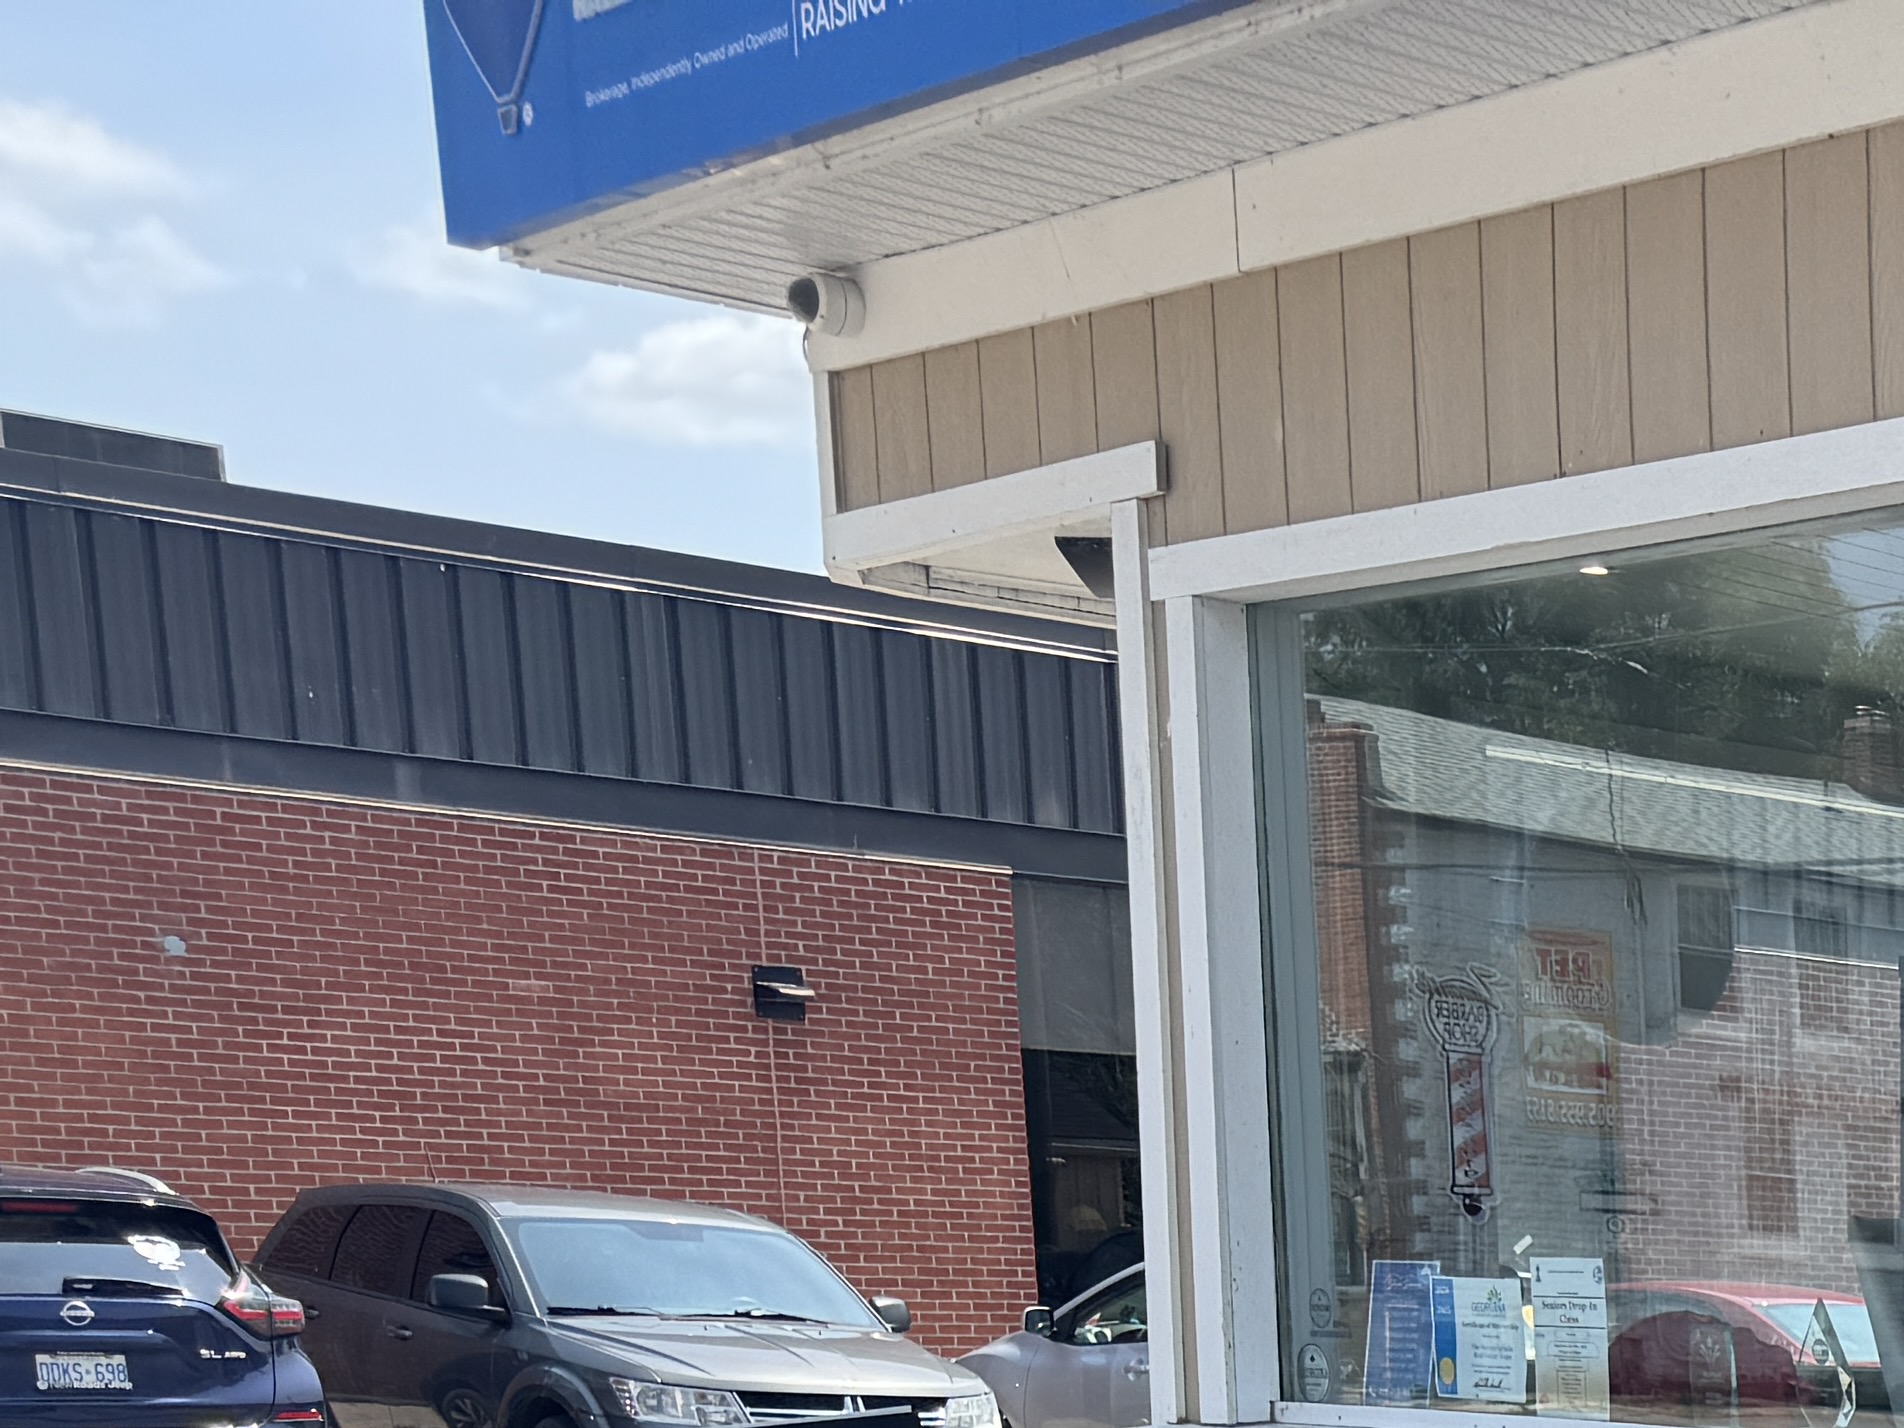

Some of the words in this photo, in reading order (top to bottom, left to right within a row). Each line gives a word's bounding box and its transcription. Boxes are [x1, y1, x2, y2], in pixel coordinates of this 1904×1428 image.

[693, 45, 726, 70] Owned
[726, 38, 746, 58] and
[745, 21, 790, 52] Operated
[95, 1363, 128, 1383] 698
